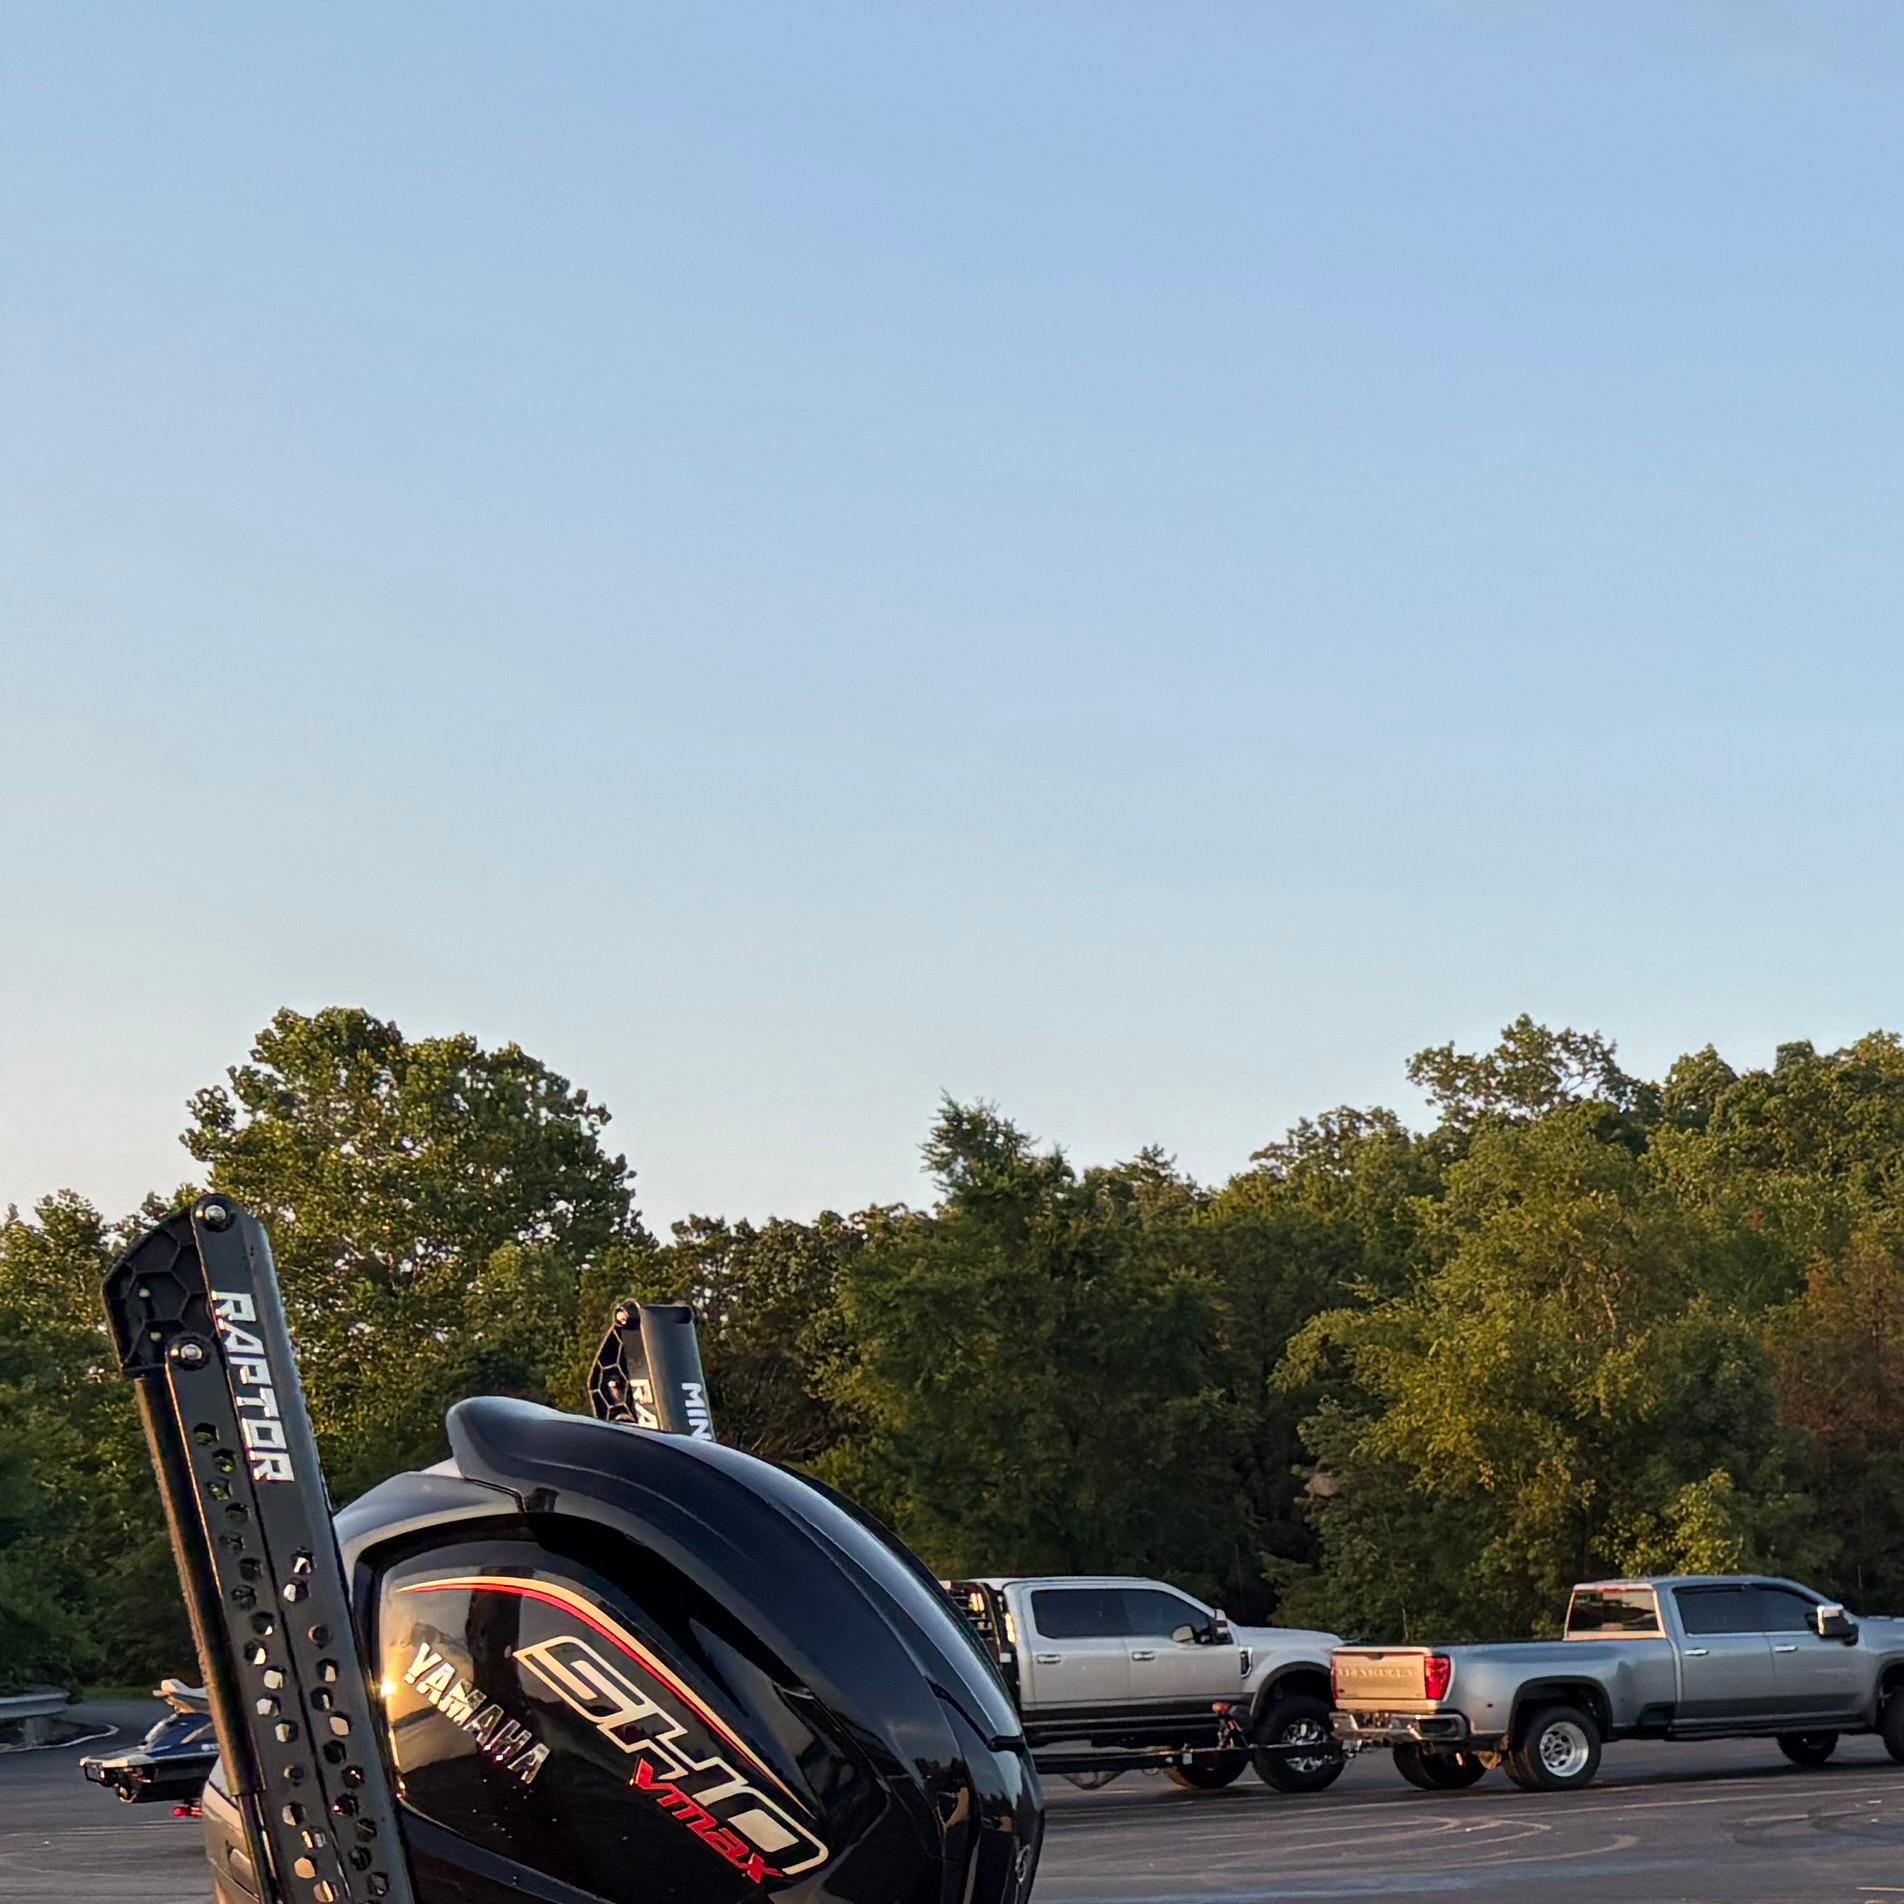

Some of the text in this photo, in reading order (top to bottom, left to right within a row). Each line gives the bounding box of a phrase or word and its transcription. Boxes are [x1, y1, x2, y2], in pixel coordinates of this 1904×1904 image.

[211, 1290, 295, 1481] RAPTOR
[404, 1642, 551, 1785] YAMAHA
[512, 1635, 829, 1876] SHO
